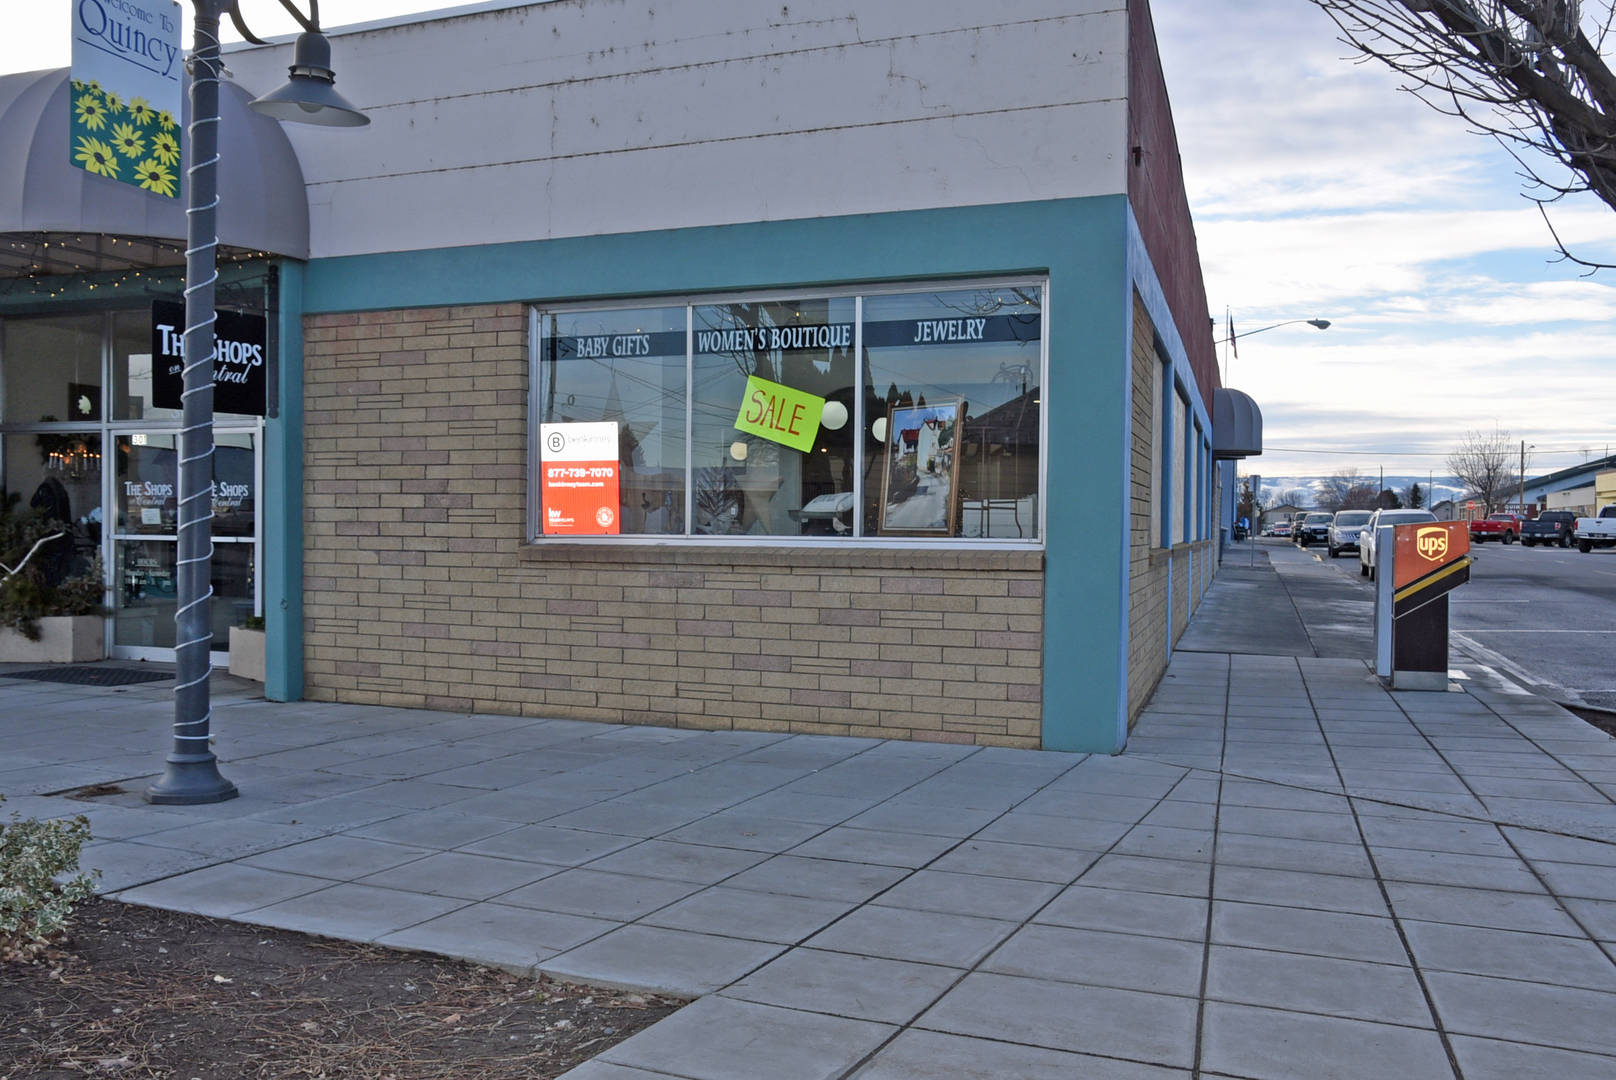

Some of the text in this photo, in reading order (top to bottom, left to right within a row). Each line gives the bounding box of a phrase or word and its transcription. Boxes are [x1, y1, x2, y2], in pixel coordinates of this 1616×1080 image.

[103, 0, 174, 33] elcome To
[79, 0, 177, 76] Quincy
[156, 324, 185, 357] TH
[697, 325, 851, 353] WOMEN'S BOUTIQUE
[914, 318, 986, 342] JEWELRY
[576, 335, 650, 358] BABY GIFTS
[746, 390, 806, 436] SALE
[552, 437, 560, 447] B
[124, 481, 173, 496] THE SHOPS
[220, 482, 249, 497] SHOPS
[1419, 537, 1446, 556] ups
